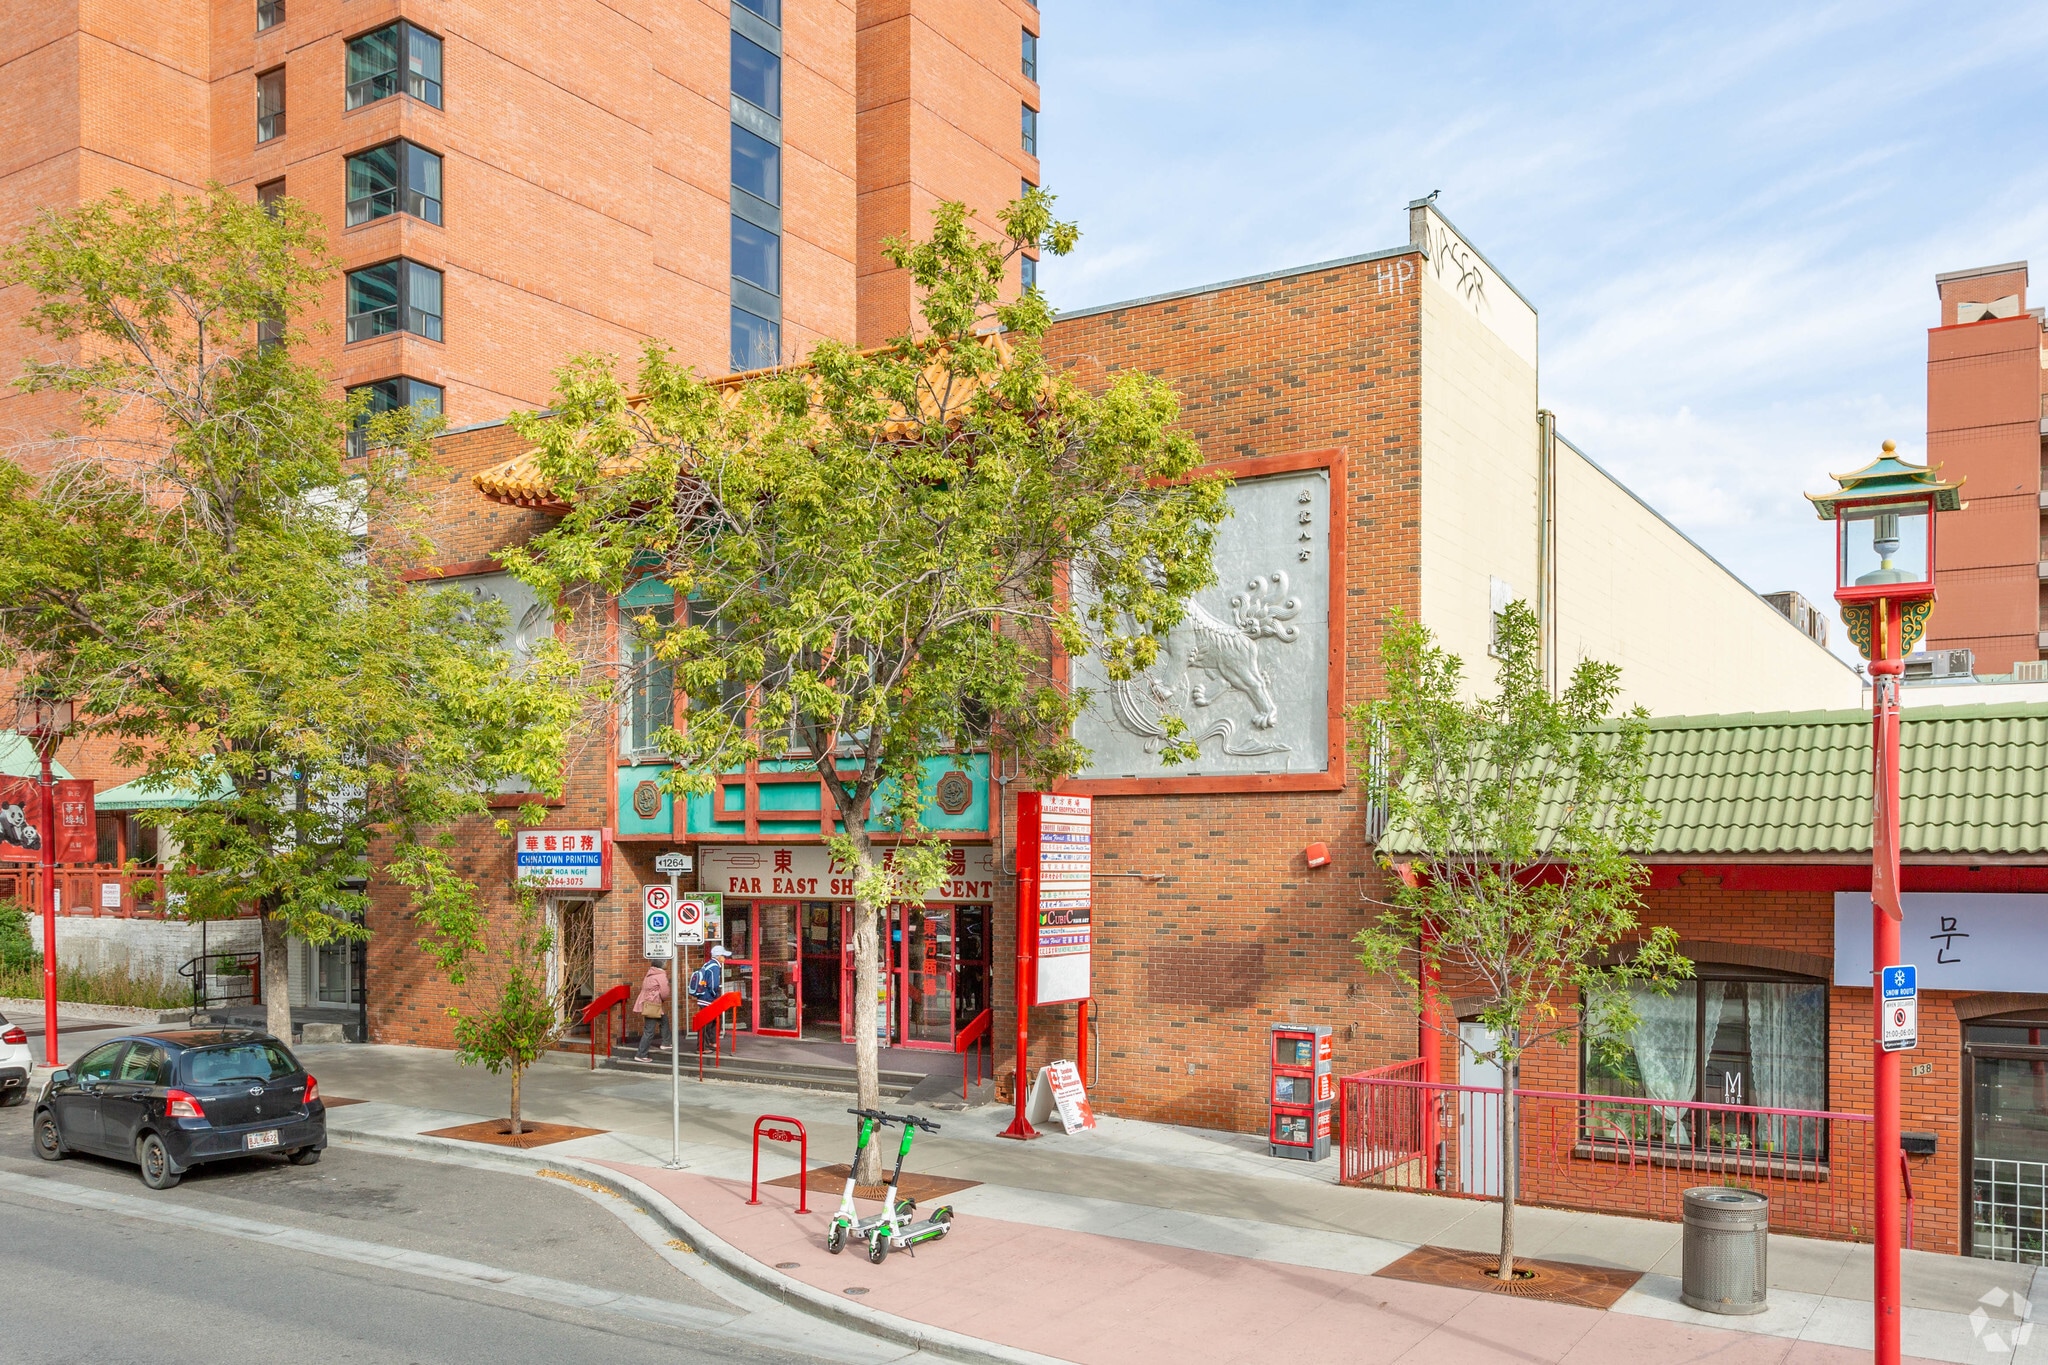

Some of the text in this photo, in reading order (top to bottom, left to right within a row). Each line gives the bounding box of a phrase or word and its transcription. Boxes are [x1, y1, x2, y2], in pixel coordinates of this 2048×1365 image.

[525, 835, 594, 851] 華藝印務
[520, 855, 599, 864] CHINATOWN PRINTING
[663, 859, 684, 867] 1264
[729, 877, 762, 893] FAR
[772, 878, 818, 894] EAST
[1930, 916, 1970, 965] 문
[1885, 987, 1914, 997] SNOW ROUTE
[1913, 1063, 1932, 1076] 138
